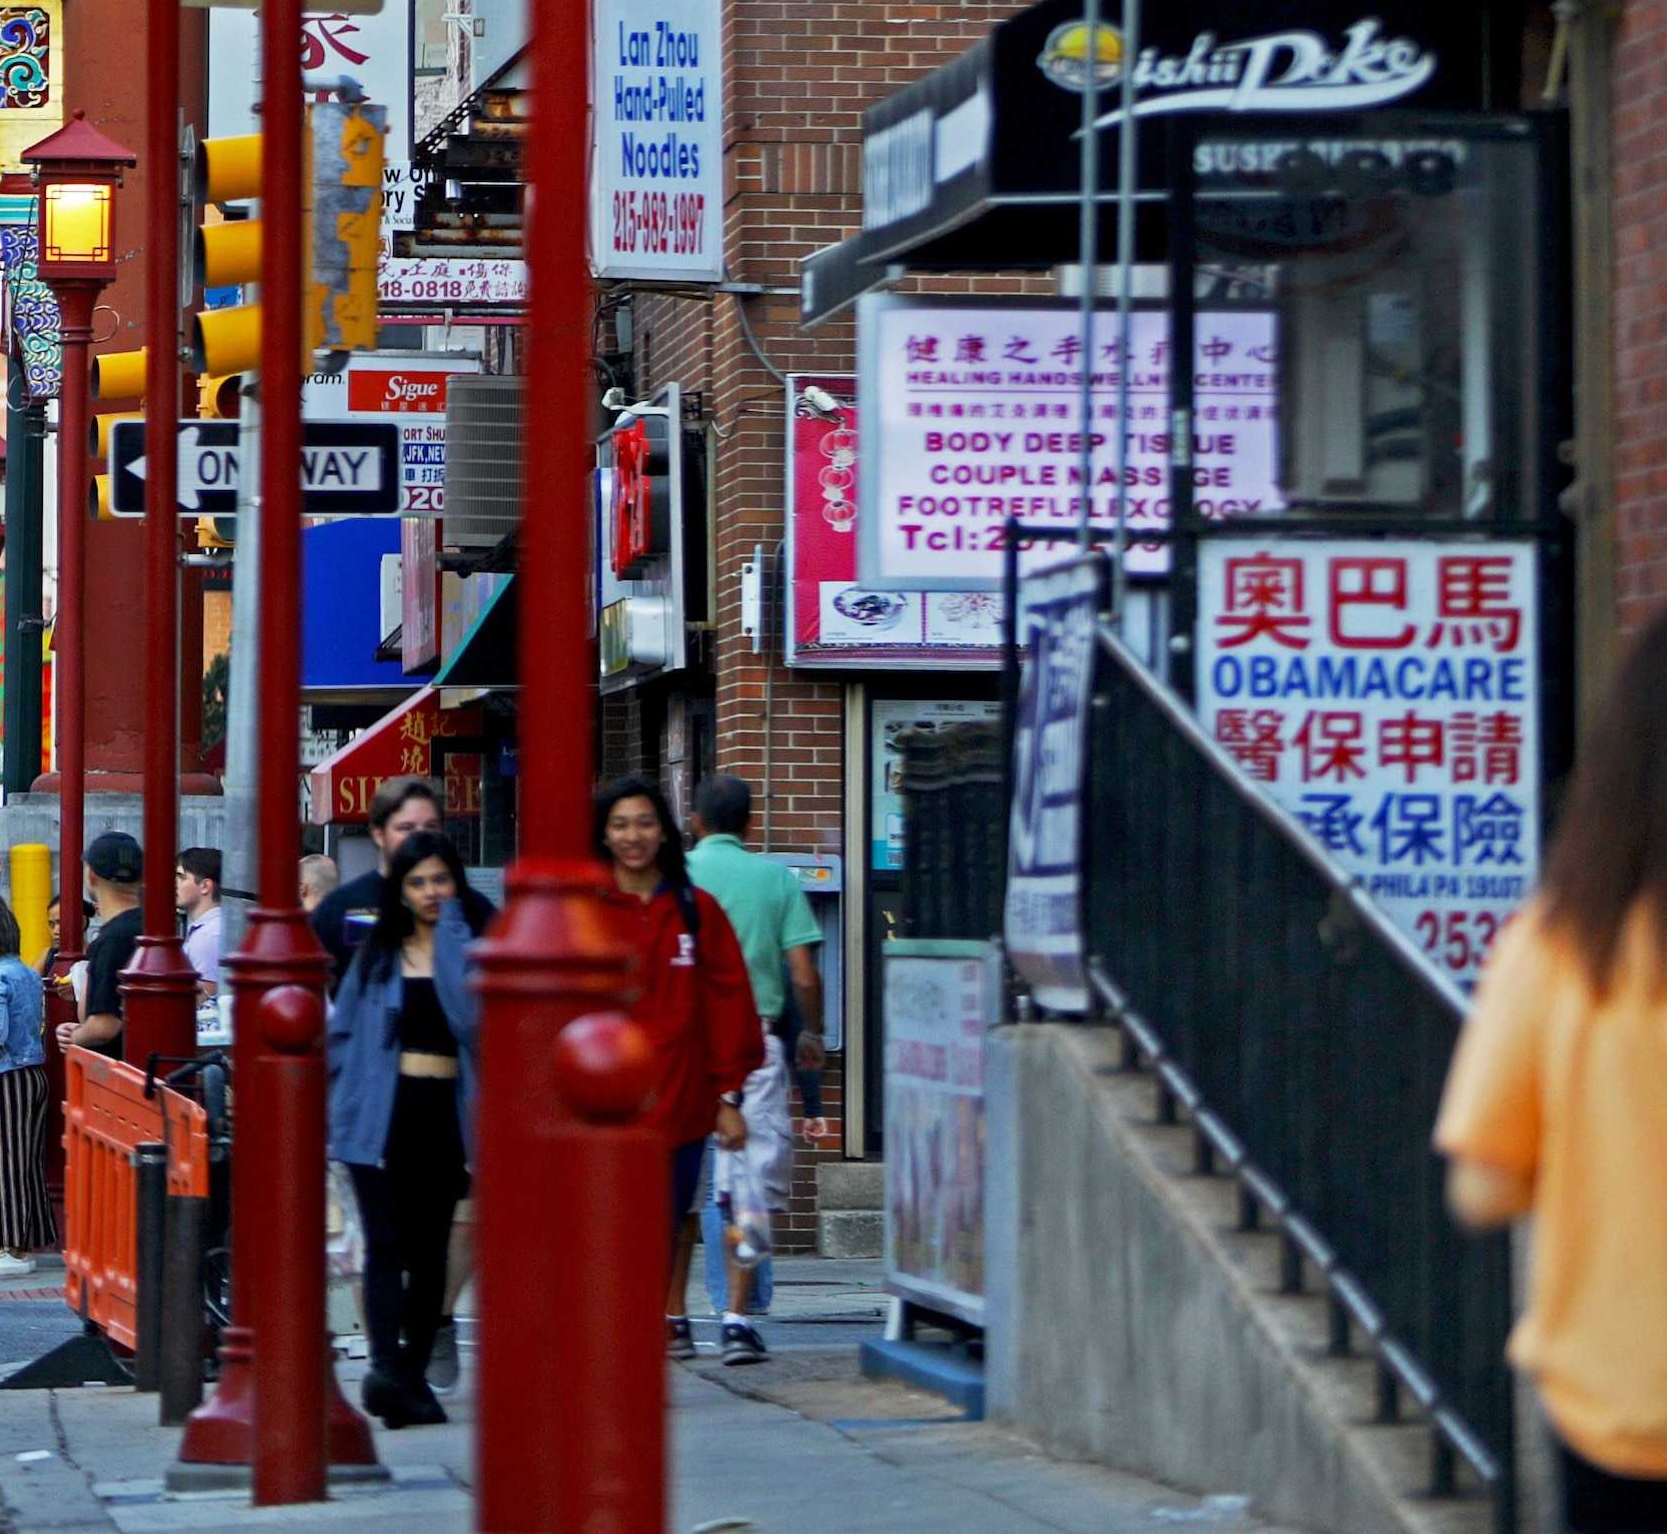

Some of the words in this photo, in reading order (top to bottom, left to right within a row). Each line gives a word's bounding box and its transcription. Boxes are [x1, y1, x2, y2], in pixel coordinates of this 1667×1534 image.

[618, 20, 651, 67] Lan
[655, 21, 699, 68] Zhou
[613, 74, 706, 123] Hand-Pulled
[621, 131, 700, 179] Noodles
[612, 189, 706, 255] 215-982-1997
[385, 375, 438, 401] Sigue
[907, 371, 1001, 385] HEALING
[1008, 372, 1080, 387] HANDS
[924, 432, 1013, 453] BODY
[1024, 433, 1105, 454] DEEP
[930, 465, 1057, 486] COUPLE
[1214, 551, 1523, 654] 奧巴馬
[1211, 655, 1526, 702] OBAMACARE
[1215, 708, 1523, 786] 醫保申請
